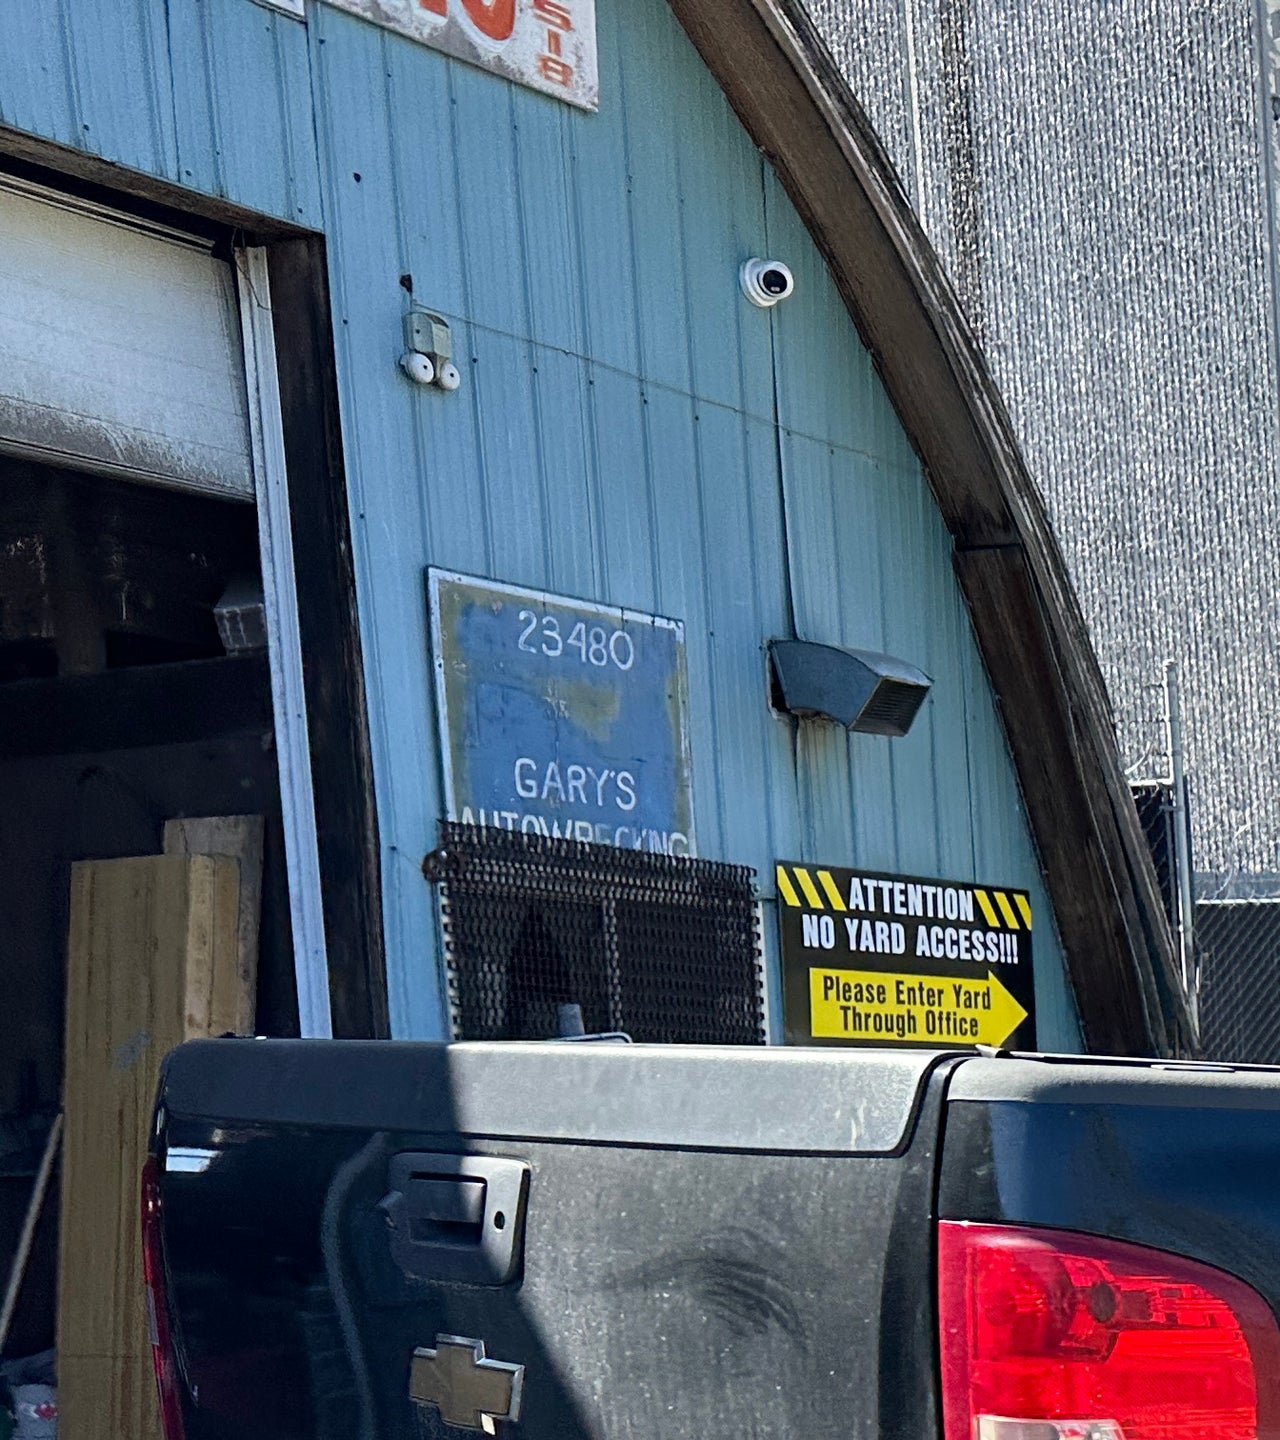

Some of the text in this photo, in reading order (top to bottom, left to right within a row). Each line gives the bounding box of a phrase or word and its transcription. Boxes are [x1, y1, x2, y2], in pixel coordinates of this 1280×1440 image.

[518, 609, 635, 671] 23480
[849, 876, 975, 922] ATTENTION
[802, 913, 1019, 964] NO YARD ACCESS!!!
[822, 975, 992, 1011] Please Enter Yard
[839, 1005, 979, 1038] Through Office
